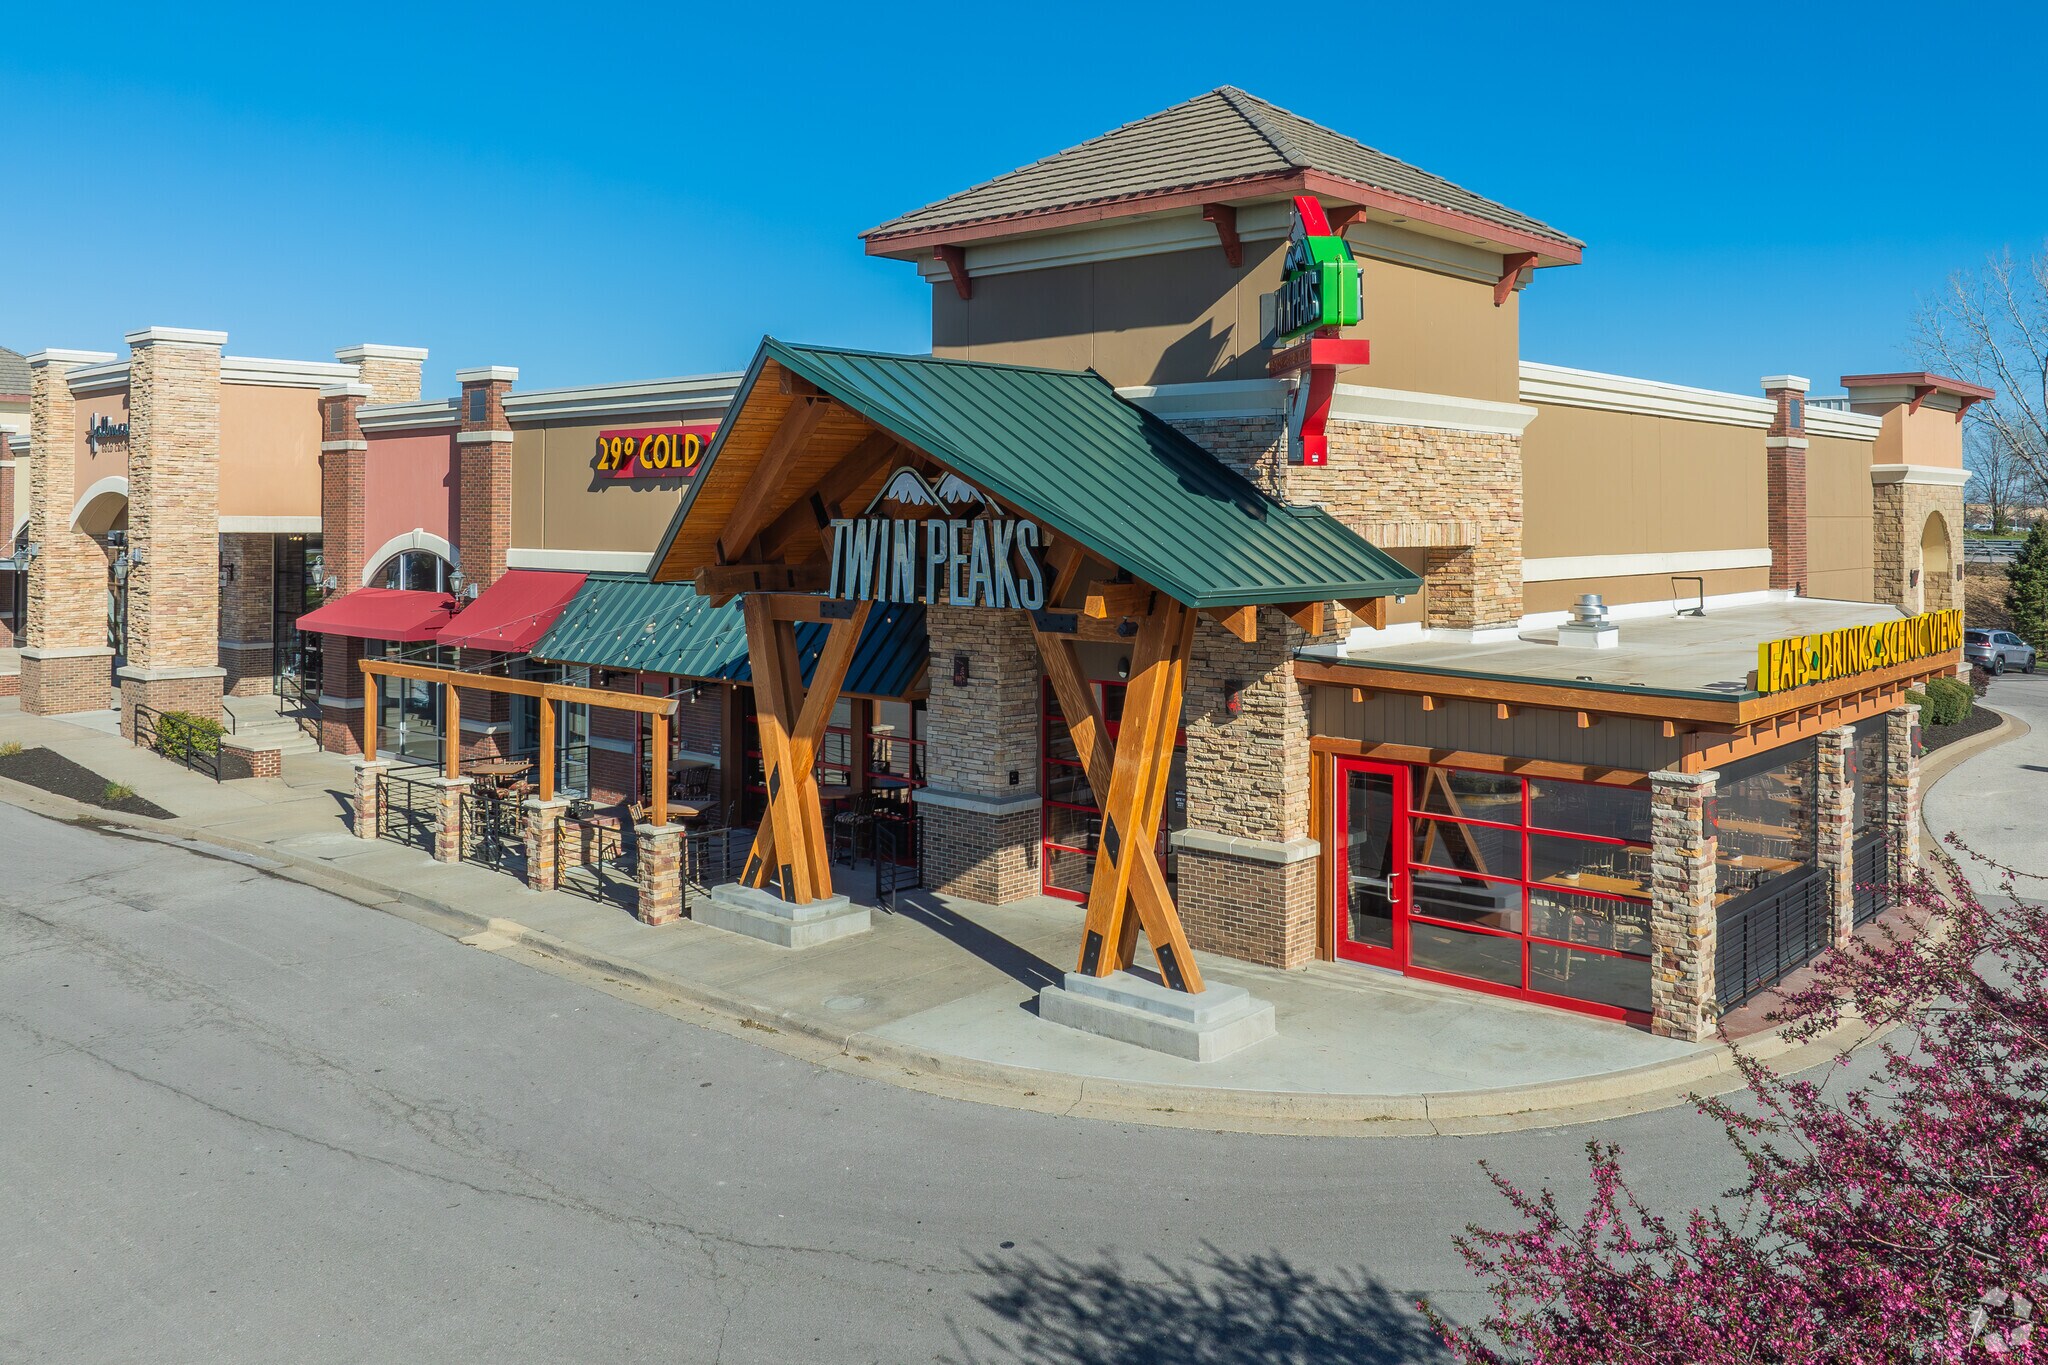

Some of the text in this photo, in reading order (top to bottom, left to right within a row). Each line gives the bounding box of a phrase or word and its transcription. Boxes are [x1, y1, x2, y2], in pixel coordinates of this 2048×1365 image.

[1292, 271, 1319, 329] PEAKS
[640, 433, 699, 469] COLD
[829, 519, 1043, 610] TWIN PEAKS
[1769, 609, 1963, 692] EATS DRINKS SCENIC VIEWS
